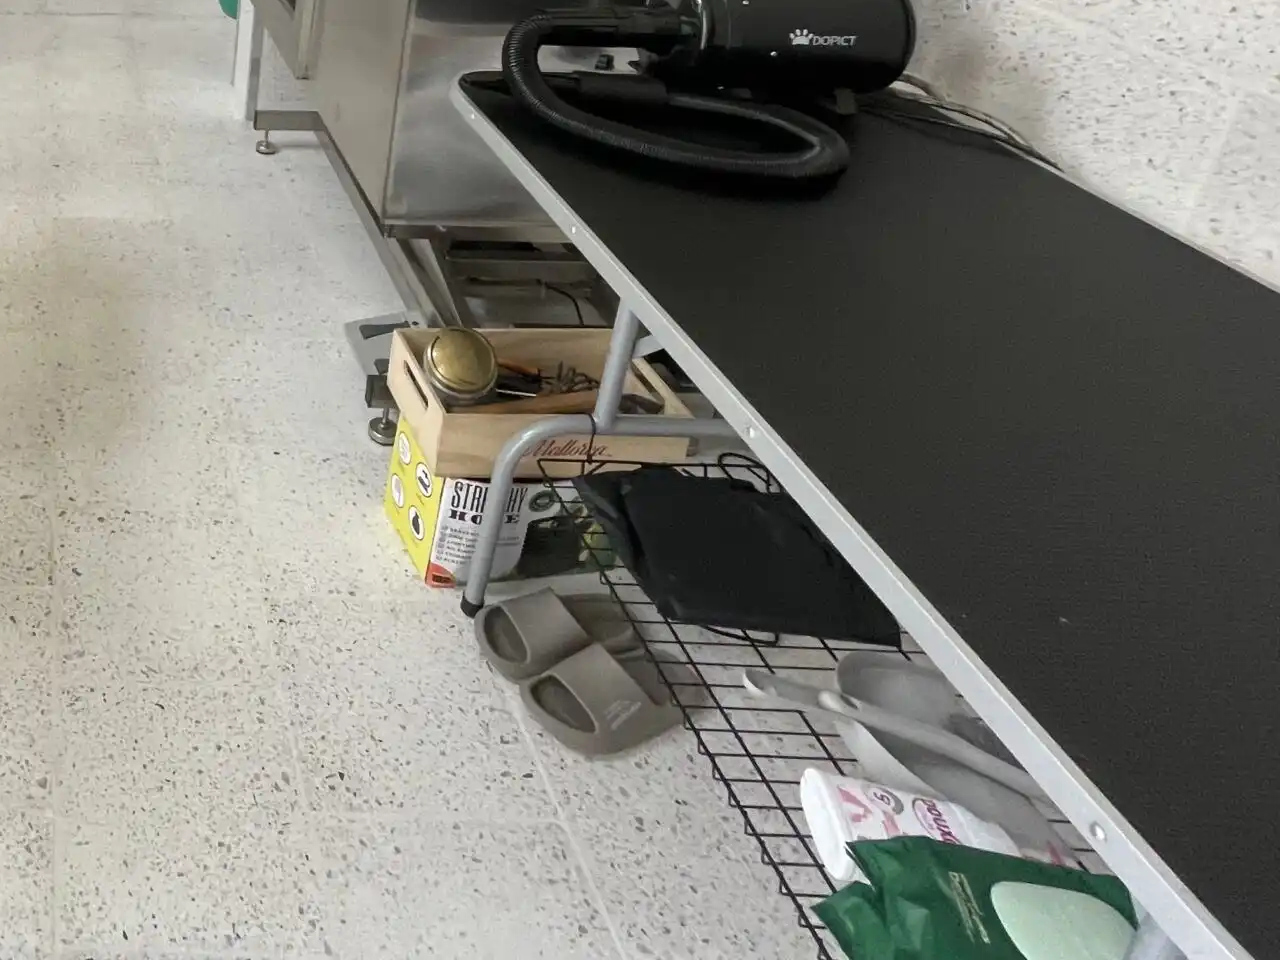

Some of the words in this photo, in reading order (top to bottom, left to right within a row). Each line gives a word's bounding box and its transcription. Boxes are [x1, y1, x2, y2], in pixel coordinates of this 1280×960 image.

[812, 36, 857, 46] DOPICT
[451, 481, 528, 513] STRHY
[449, 509, 519, 525] HOE
